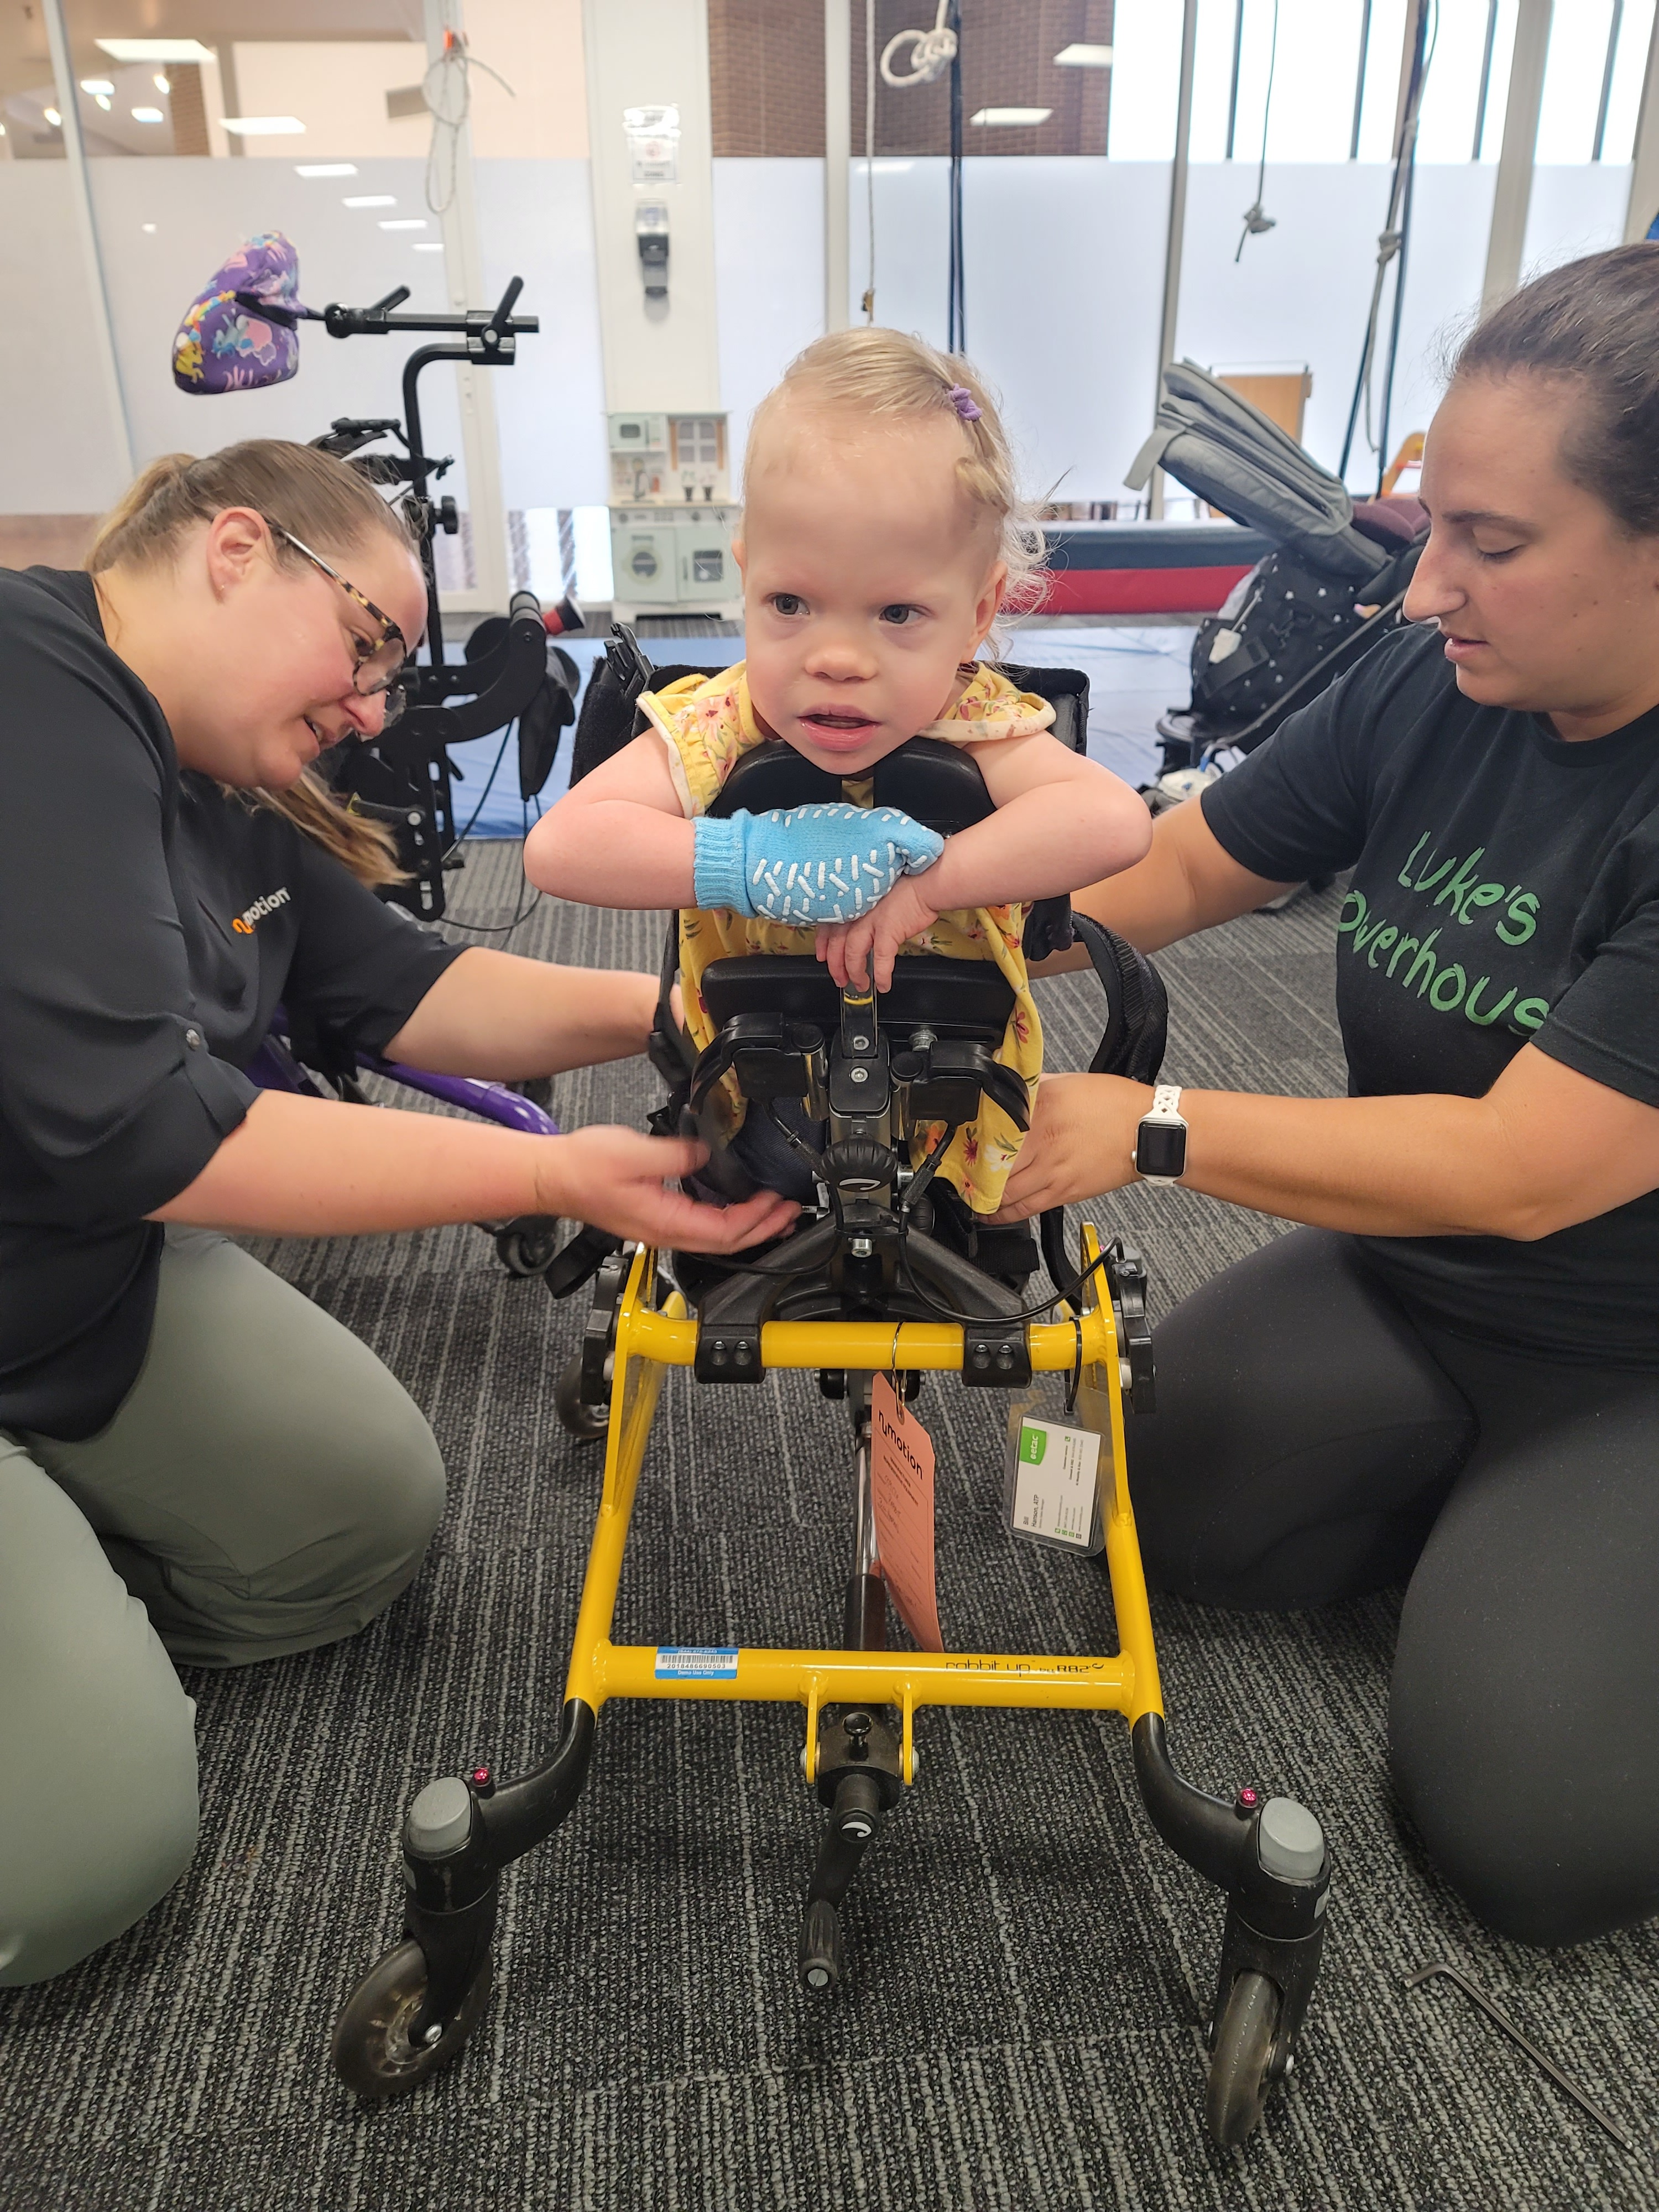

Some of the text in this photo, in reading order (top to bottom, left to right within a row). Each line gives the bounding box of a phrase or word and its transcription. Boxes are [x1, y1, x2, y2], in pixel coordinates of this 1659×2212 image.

[1397, 831, 1541, 946] Luke's
[879, 1410, 923, 1480] numotion
[946, 1659, 1000, 1671] rabbit
[1006, 1663, 1030, 1677] up
[1057, 1665, 1089, 1673] R82
